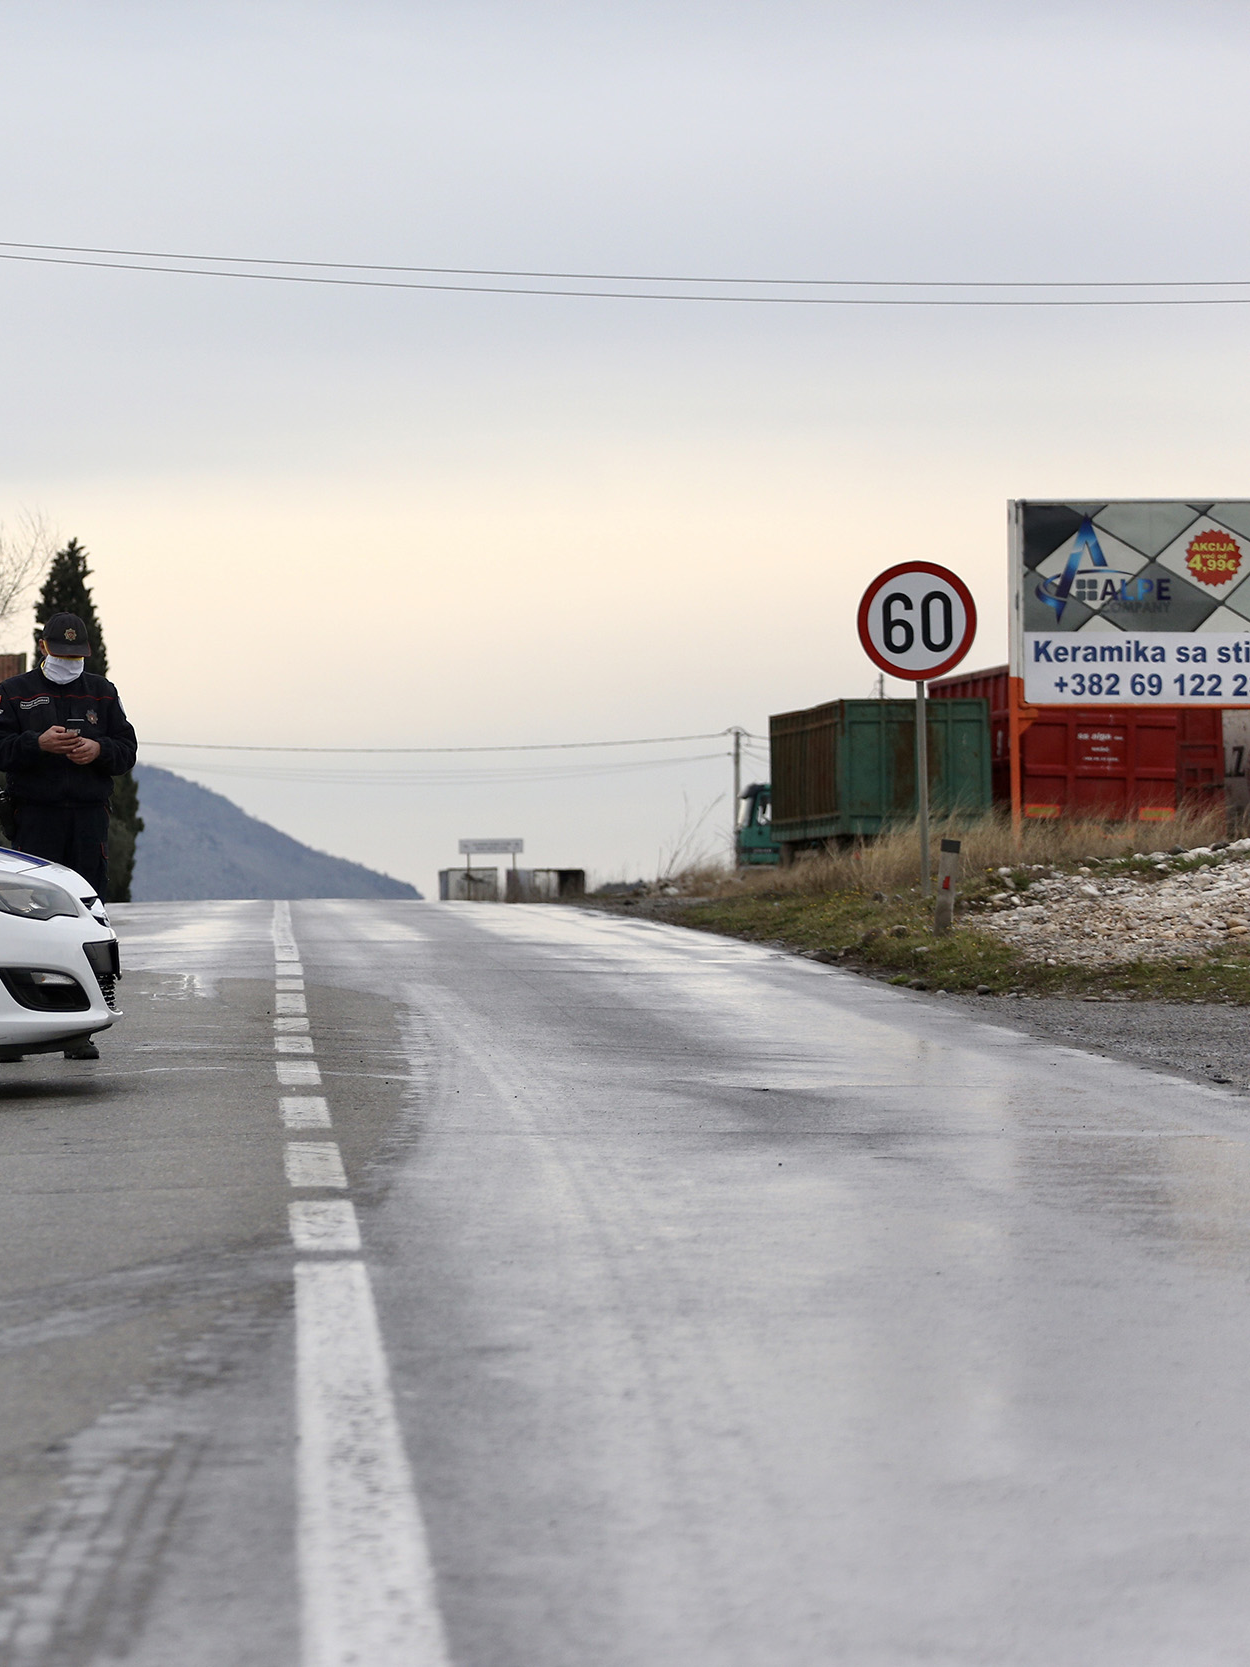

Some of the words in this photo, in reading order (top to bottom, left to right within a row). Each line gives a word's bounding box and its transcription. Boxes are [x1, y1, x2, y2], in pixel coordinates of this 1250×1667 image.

[1191, 542, 1236, 552] AKCIJA
[1188, 554, 1236, 573] 4,99€
[1100, 578, 1171, 601] ALPE
[1102, 601, 1171, 613] COMPANY
[882, 590, 953, 654] 60
[1033, 640, 1166, 663] Keramika
[1175, 645, 1207, 663] sa
[1054, 673, 1120, 696] +382
[1130, 673, 1162, 696] 69
[1174, 673, 1222, 696] 122
[1232, 673, 1250, 696] 2
